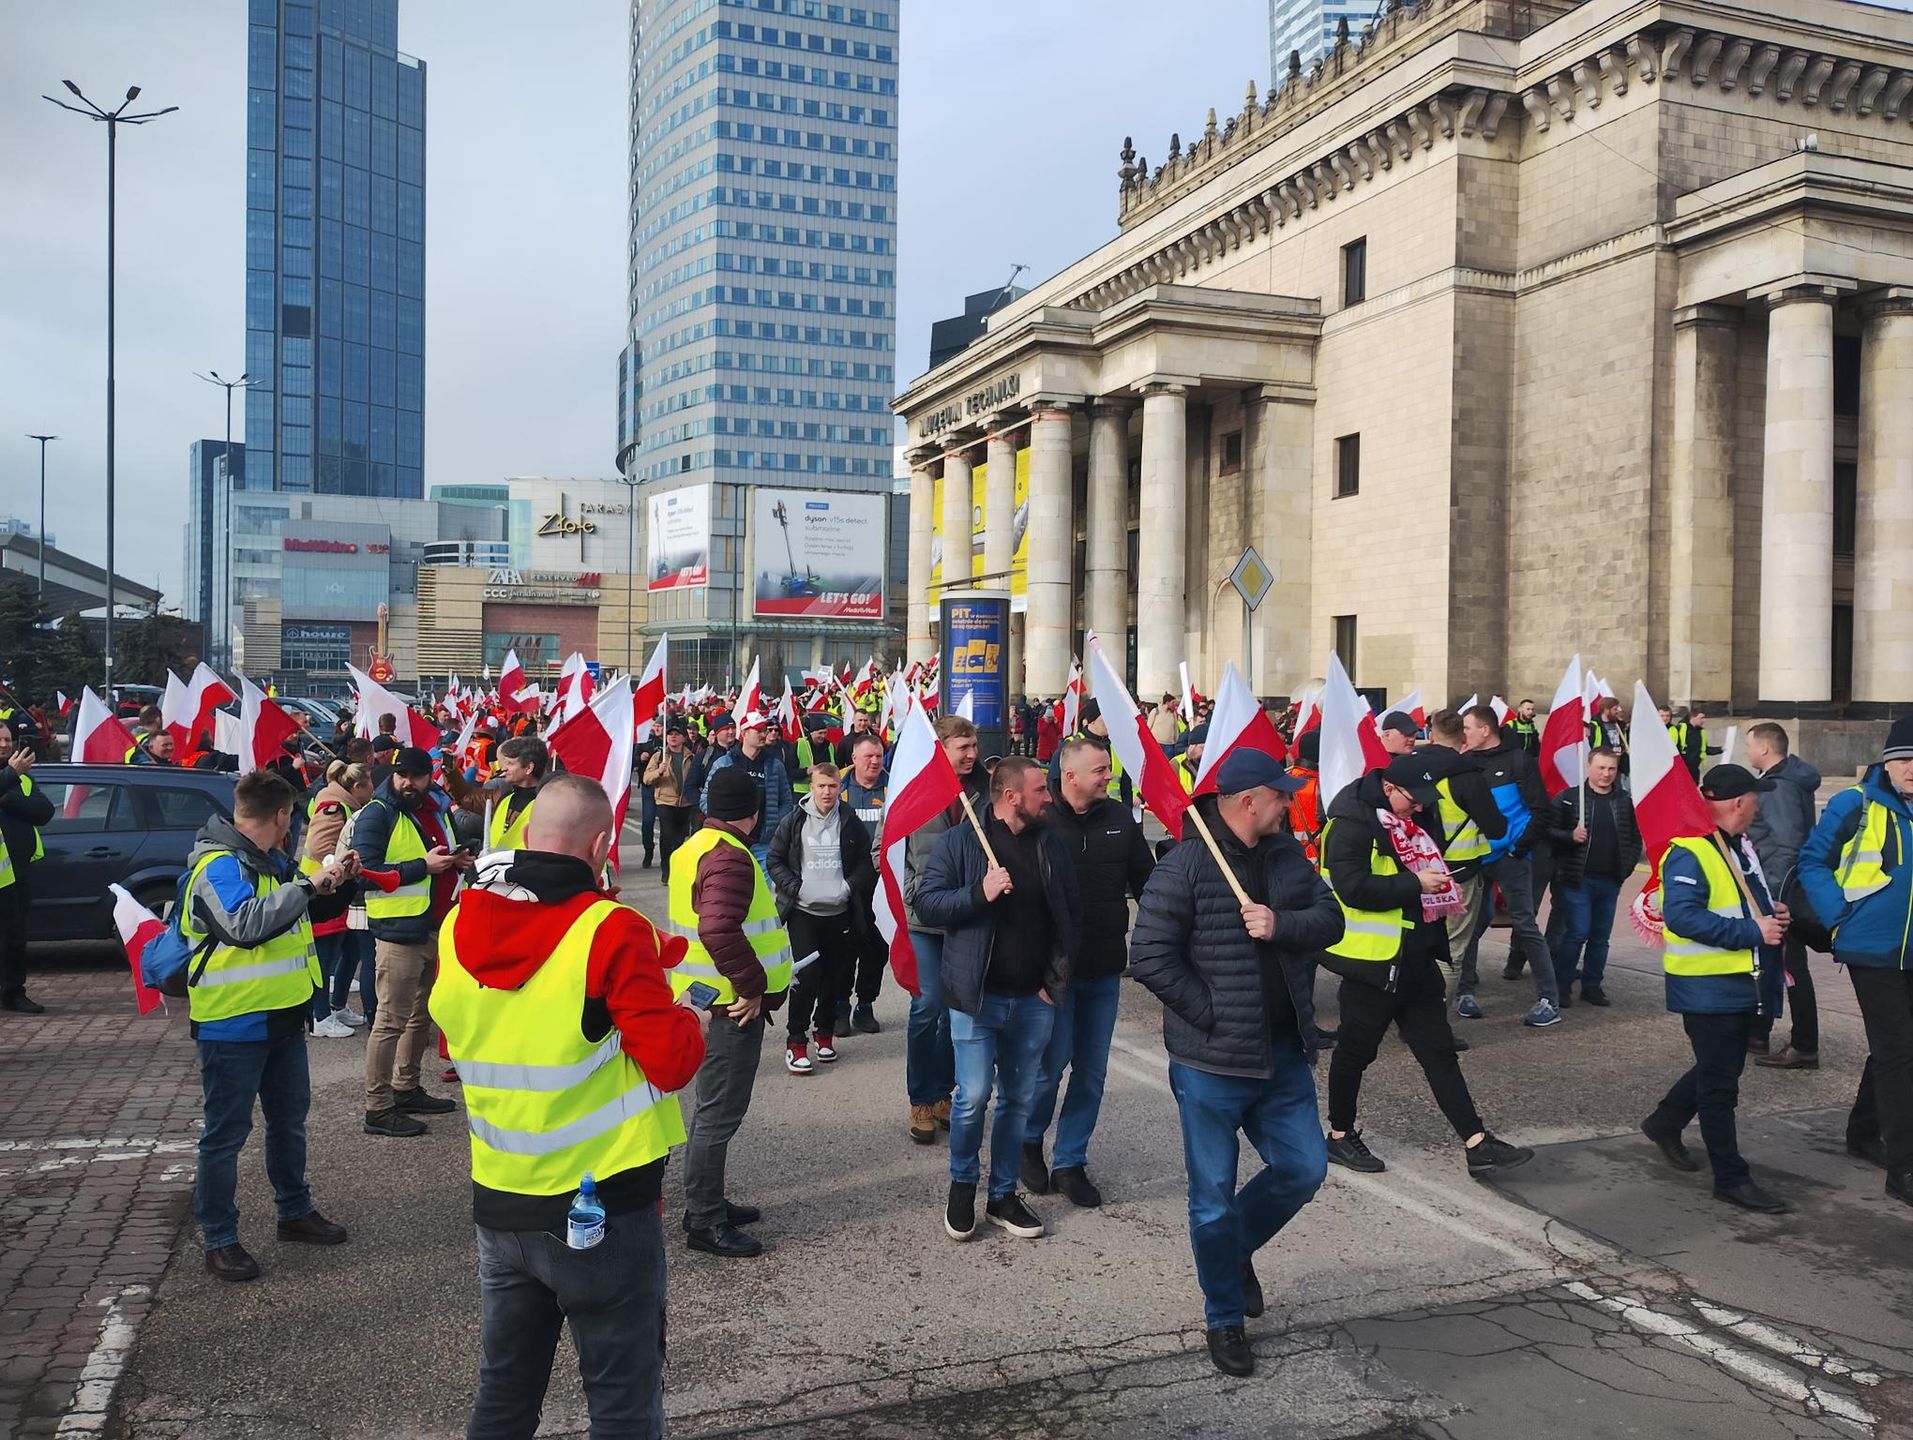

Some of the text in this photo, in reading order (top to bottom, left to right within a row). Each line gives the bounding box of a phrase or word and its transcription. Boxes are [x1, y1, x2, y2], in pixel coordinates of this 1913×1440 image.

[919, 373, 1020, 438] MUZEUM TECHNIKI
[804, 515, 827, 524] dyson
[487, 568, 524, 585] ZARA
[483, 588, 508, 598] CCC
[820, 591, 871, 605] LET'S GO!
[951, 608, 971, 619] PIT
[300, 629, 346, 639] house
[806, 858, 842, 869] adidas
